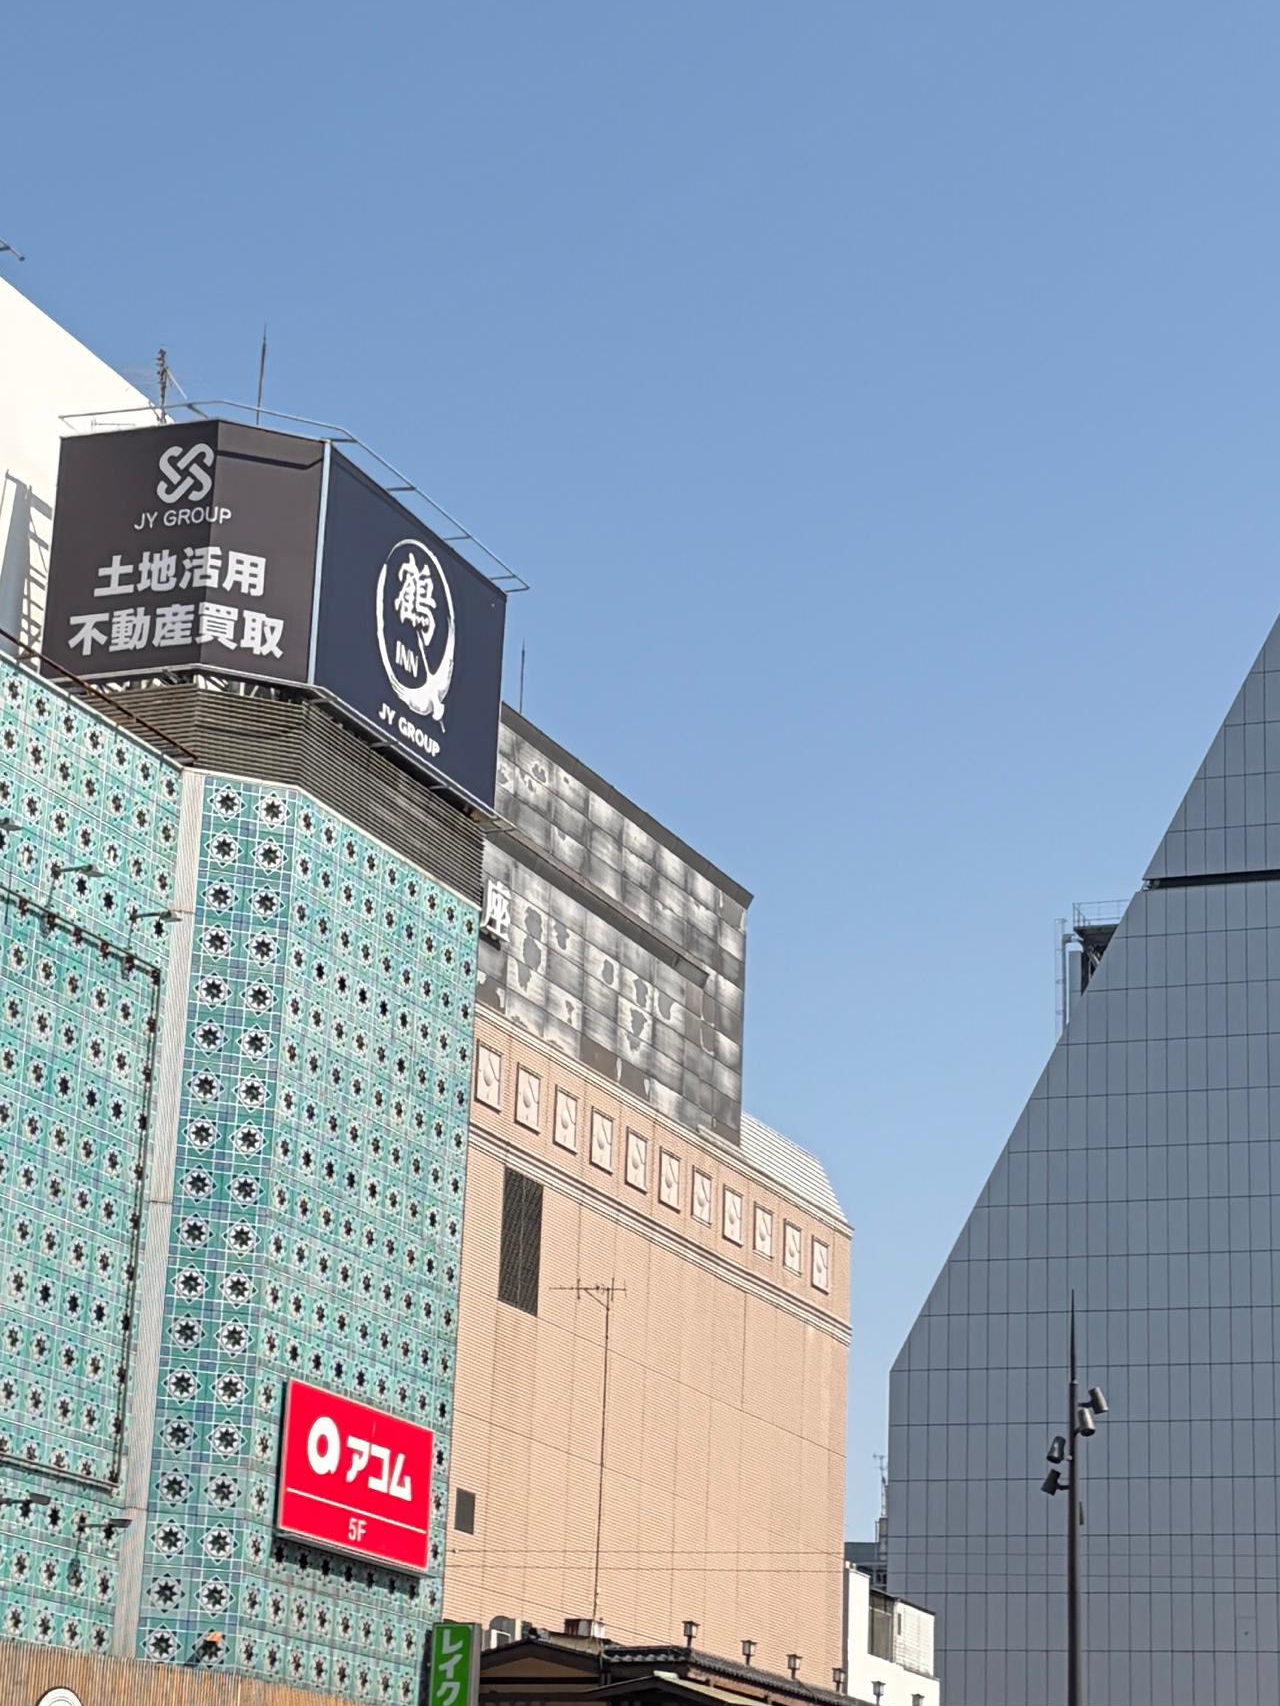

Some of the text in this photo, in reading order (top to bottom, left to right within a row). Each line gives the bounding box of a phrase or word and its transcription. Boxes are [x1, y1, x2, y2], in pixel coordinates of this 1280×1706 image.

[134, 506, 232, 530] JY GROUP
[93, 546, 266, 597] 土地活用
[68, 601, 285, 659] 不動産買取
[395, 640, 419, 678] INN
[378, 702, 441, 758] JY GROUP
[345, 1435, 412, 1502] アコム
[348, 1517, 368, 1542] 5F
